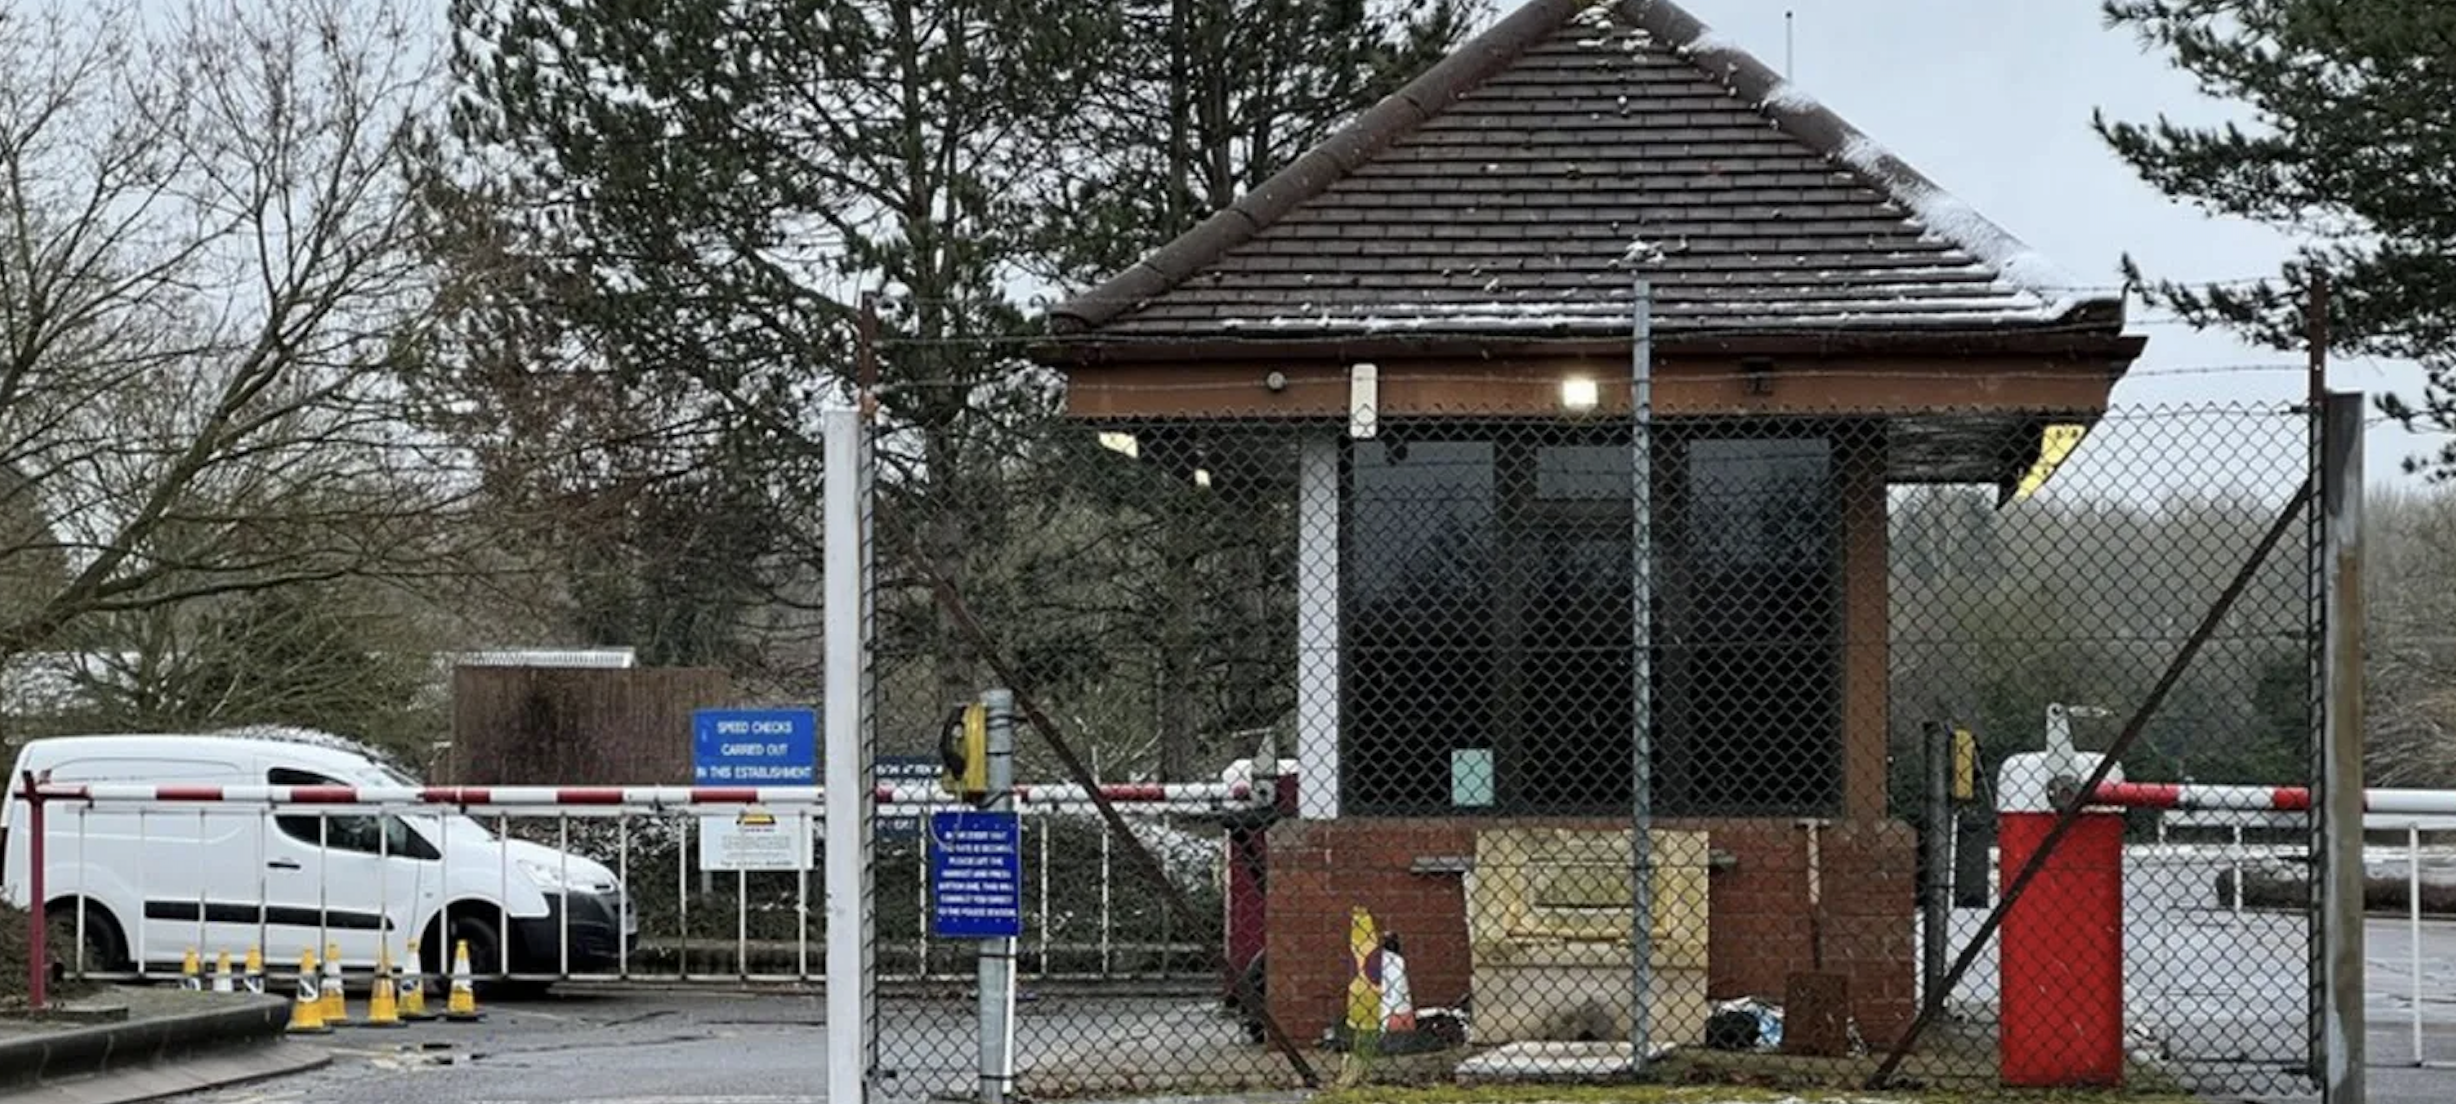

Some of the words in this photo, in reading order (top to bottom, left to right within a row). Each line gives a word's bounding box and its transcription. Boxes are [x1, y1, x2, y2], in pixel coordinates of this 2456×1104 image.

[717, 720, 749, 734] SPEED
[751, 720, 793, 734] CHECKS
[720, 743, 764, 756] CARRIED
[766, 743, 788, 756] OUT
[696, 766, 707, 778] IN
[709, 766, 732, 779] THIS
[734, 766, 812, 779] ESTABLISHMENT
